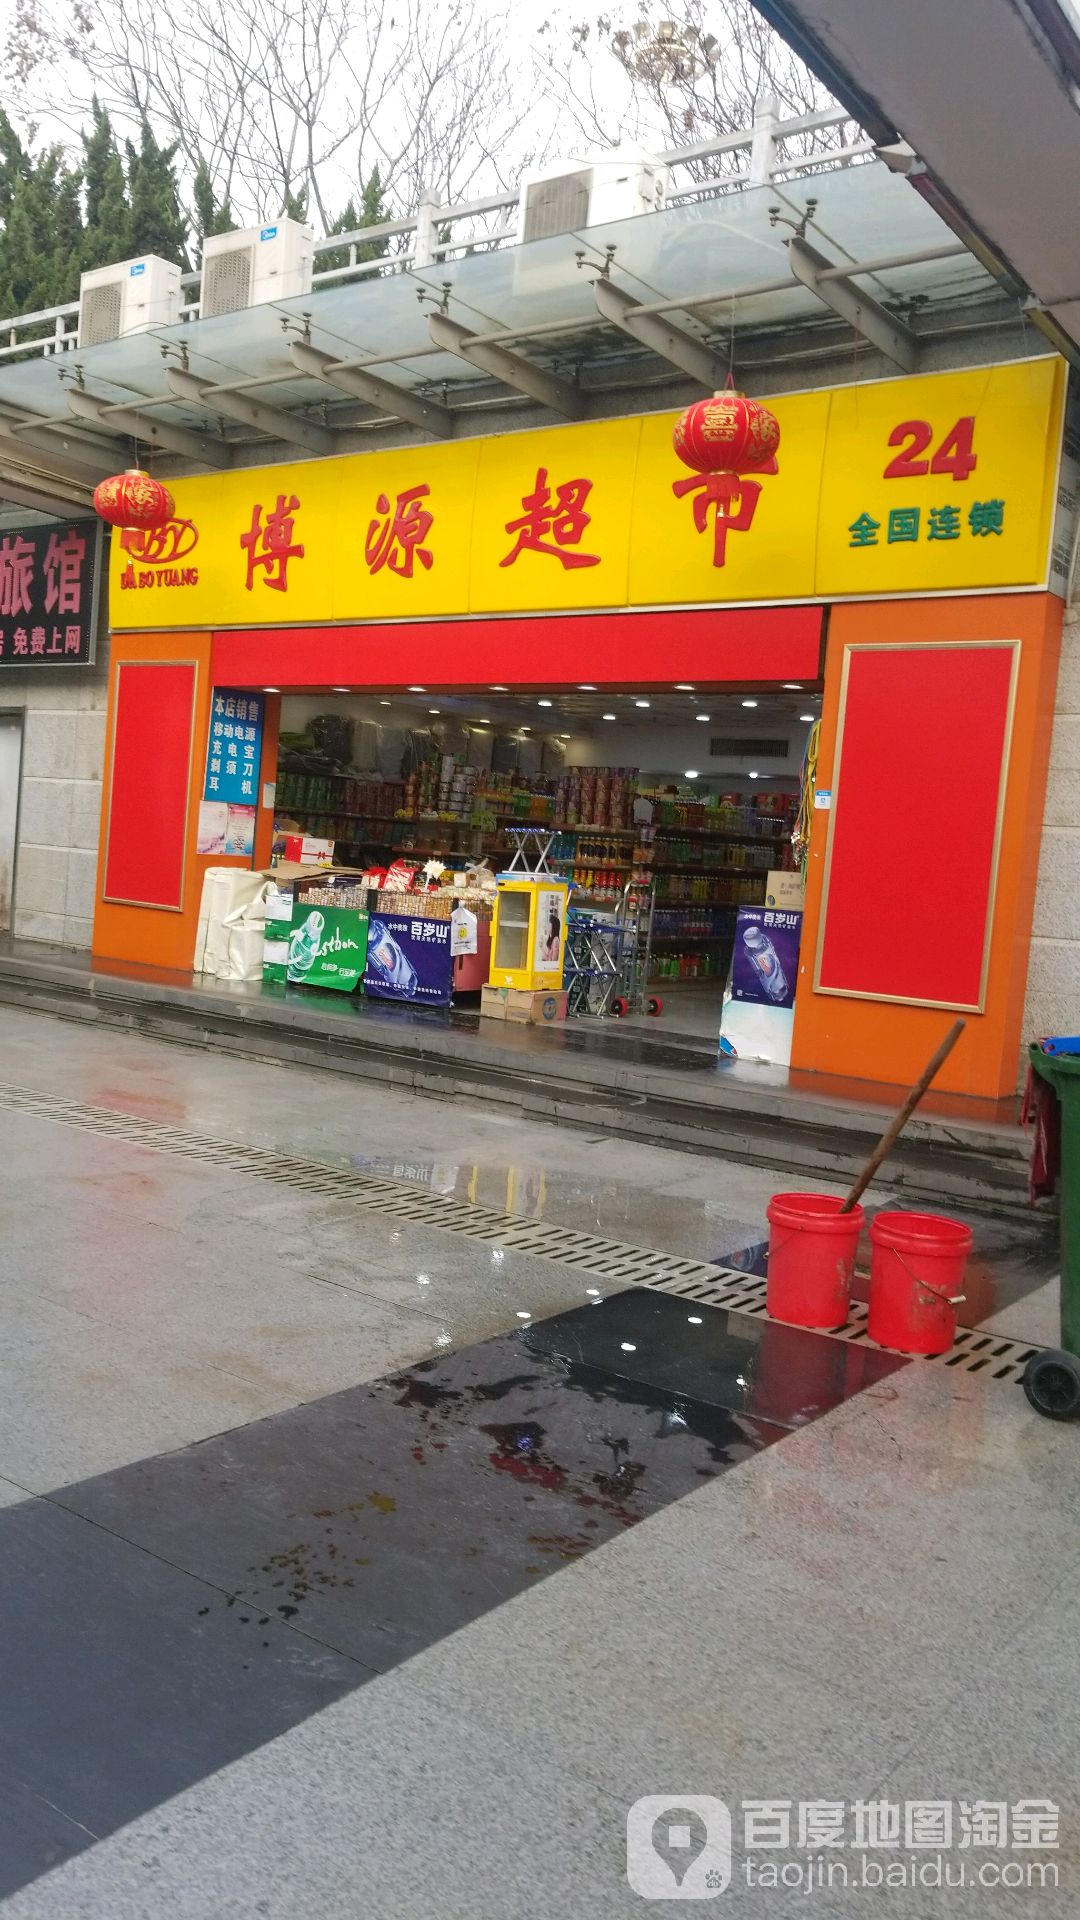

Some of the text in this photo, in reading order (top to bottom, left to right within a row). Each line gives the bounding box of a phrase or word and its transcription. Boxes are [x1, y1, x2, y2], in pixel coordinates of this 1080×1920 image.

[883, 416, 978, 482] 24
[240, 457, 779, 593] 博源超市
[848, 499, 1006, 547] 全国连锁
[0, 530, 86, 617] 旅馆
[13, 625, 81, 655] 免费上网
[214, 696, 260, 722] 本店销售
[213, 721, 256, 742] 移动电源
[212, 740, 255, 760] 充电宝
[210, 758, 253, 777] 剃须刀
[208, 776, 252, 795] 耳机
[410, 921, 448, 939] 百岁山
[763, 912, 797, 926] 百岁山
